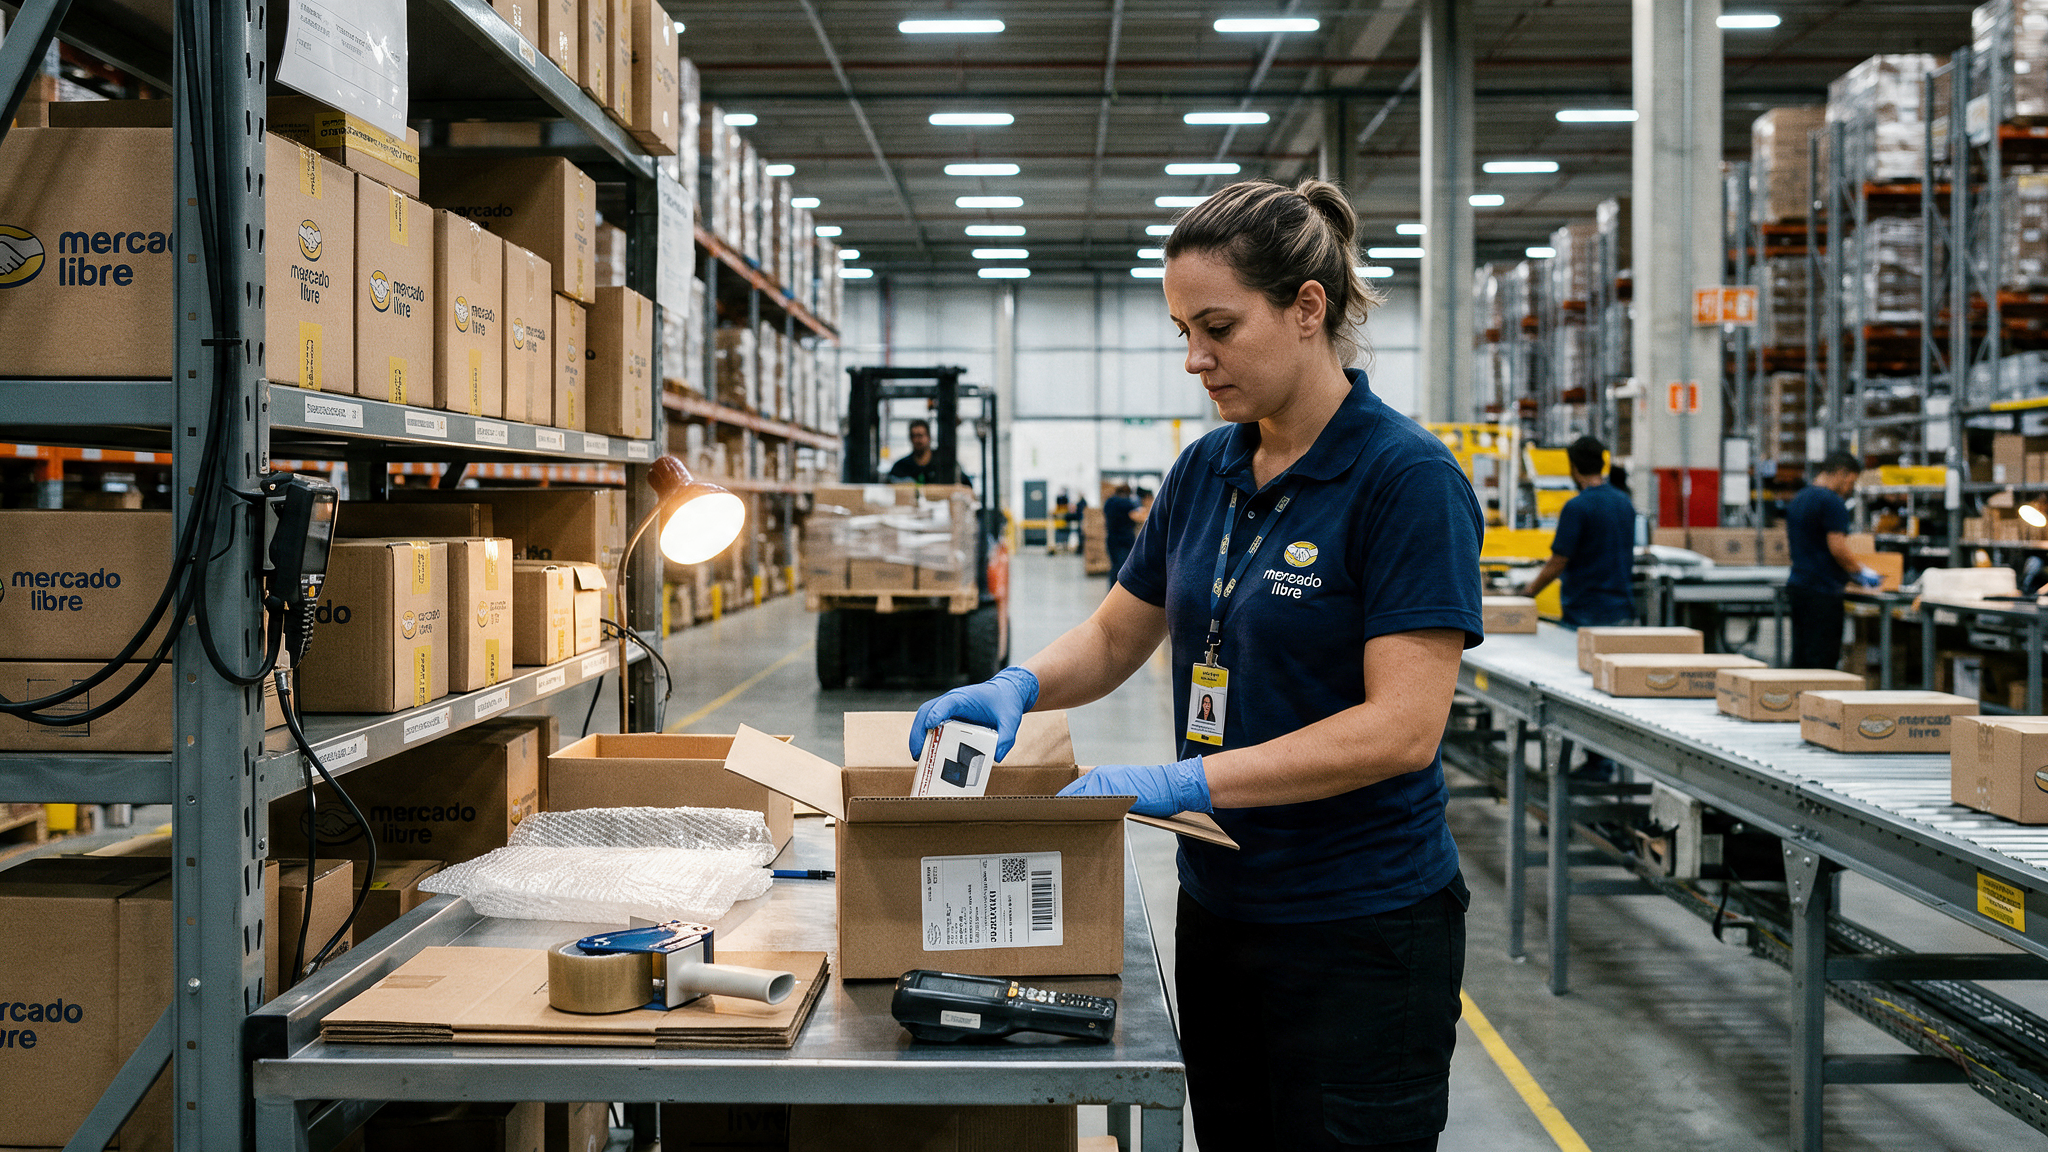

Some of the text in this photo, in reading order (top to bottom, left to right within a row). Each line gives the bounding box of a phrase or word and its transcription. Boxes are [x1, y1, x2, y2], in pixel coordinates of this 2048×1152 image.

[59, 231, 173, 254] merca
[59, 257, 134, 287] libre
[11, 567, 122, 589] mercado
[31, 589, 84, 612] libre
[369, 801, 476, 823] mercado
